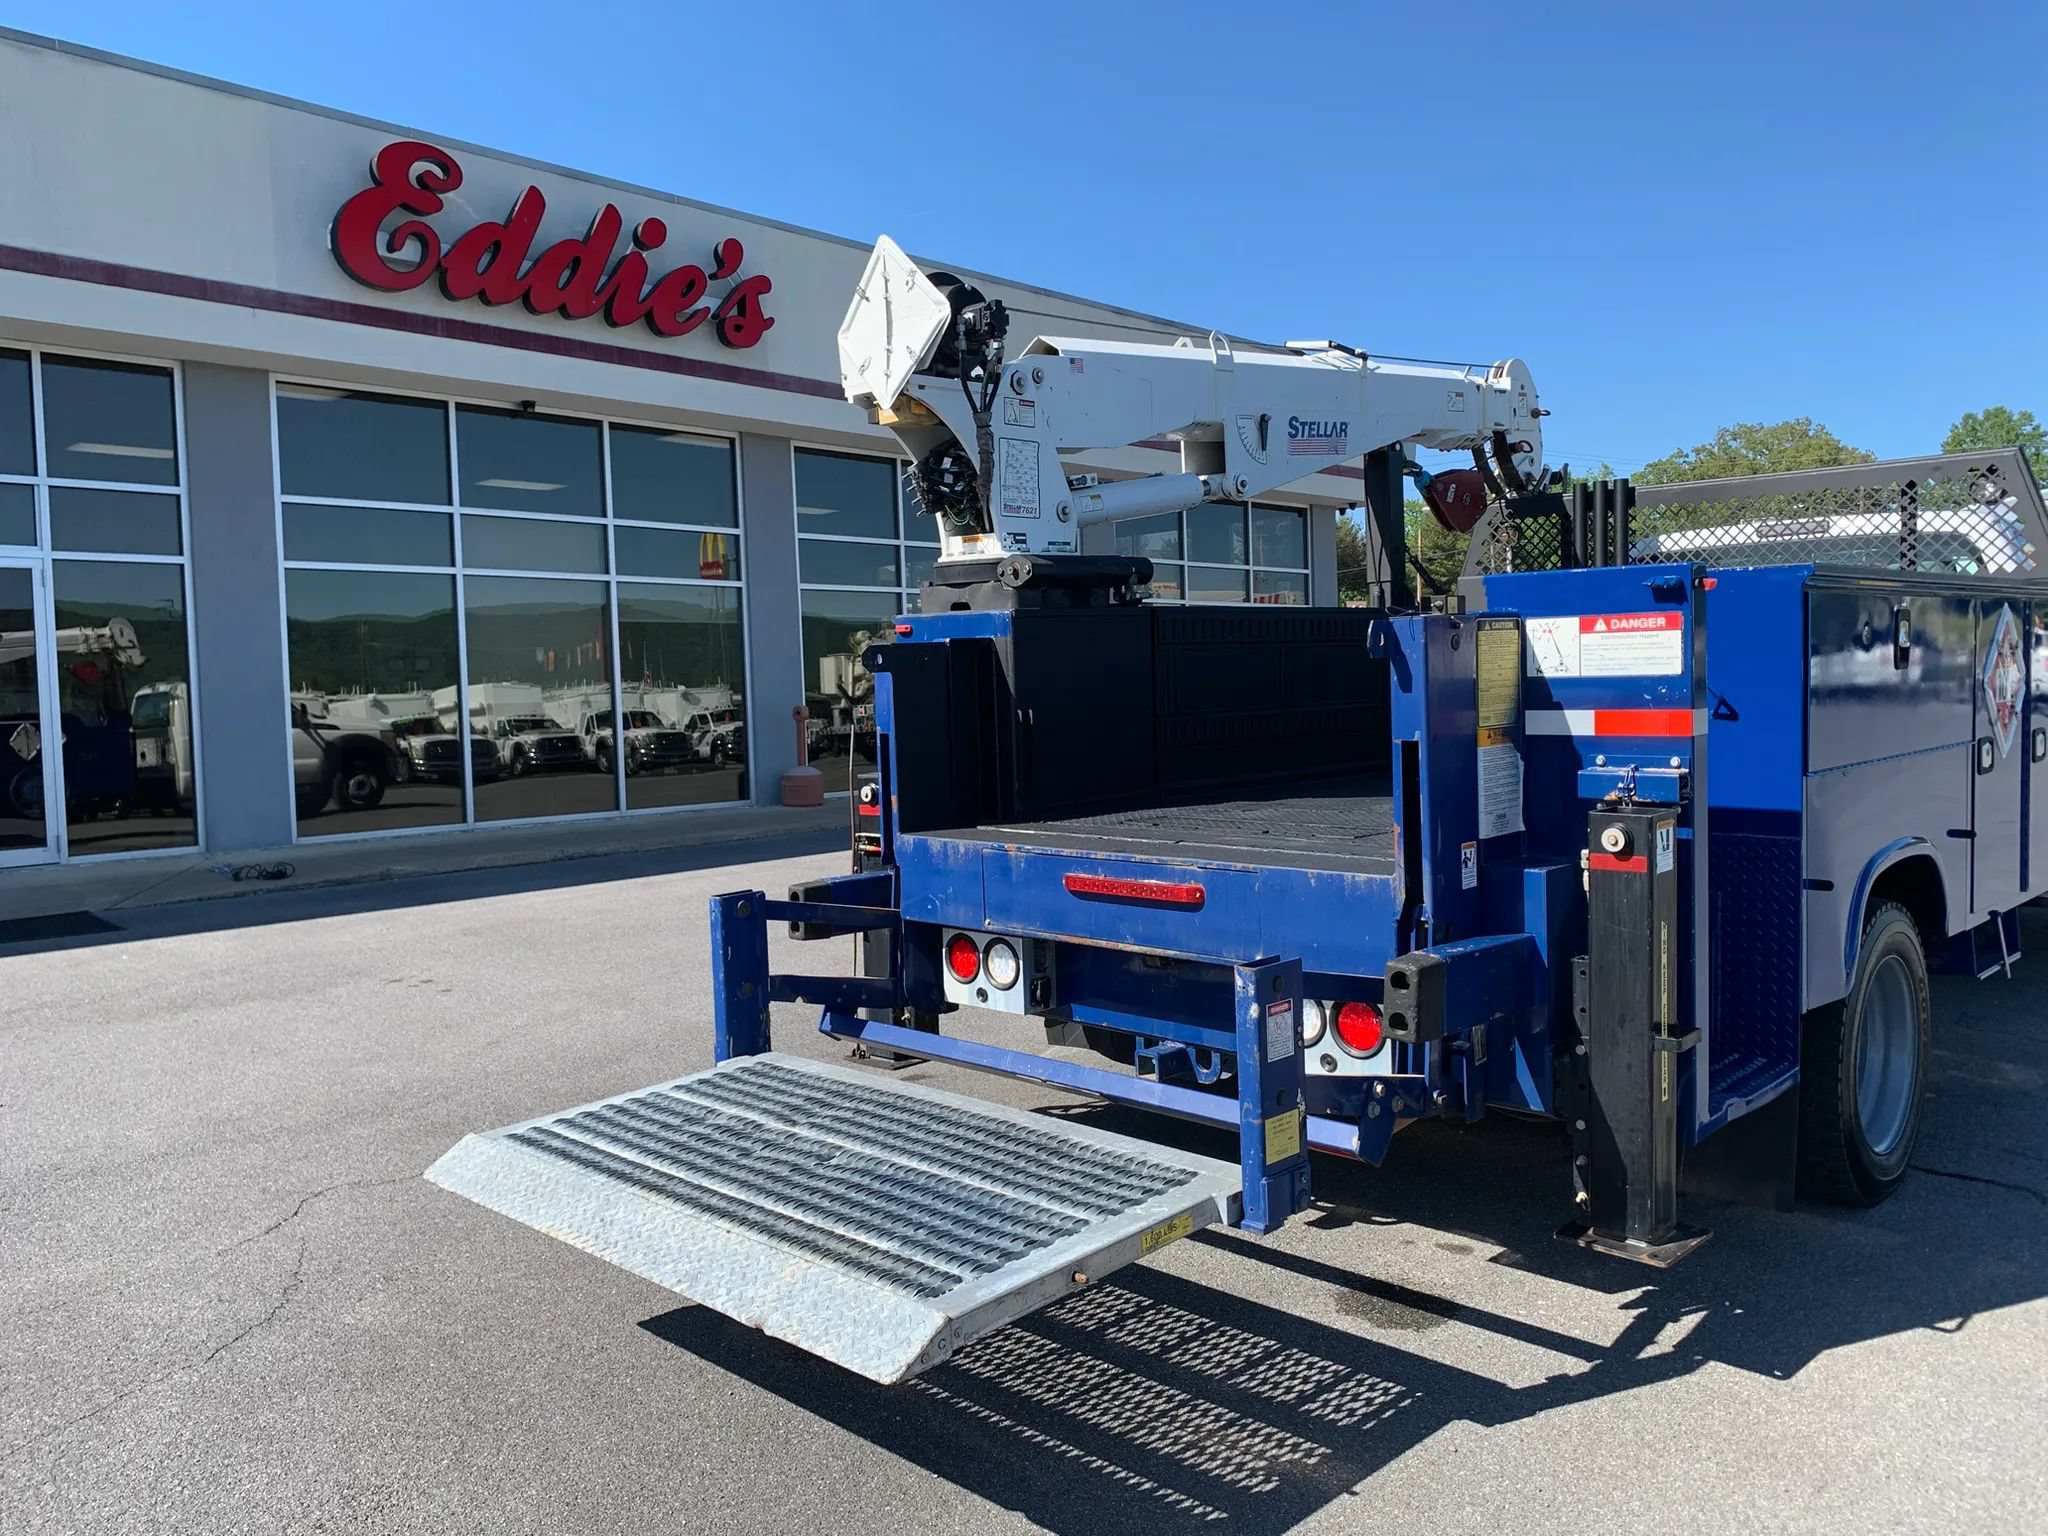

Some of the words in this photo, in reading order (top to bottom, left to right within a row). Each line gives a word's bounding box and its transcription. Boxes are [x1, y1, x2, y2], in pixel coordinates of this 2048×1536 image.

[330, 140, 775, 349] Eddie's
[1288, 416, 1348, 438] STELLAR
[1021, 506, 1037, 514] 7621
[1491, 621, 1514, 629] CAUTION
[1610, 617, 1666, 630] DANGER
